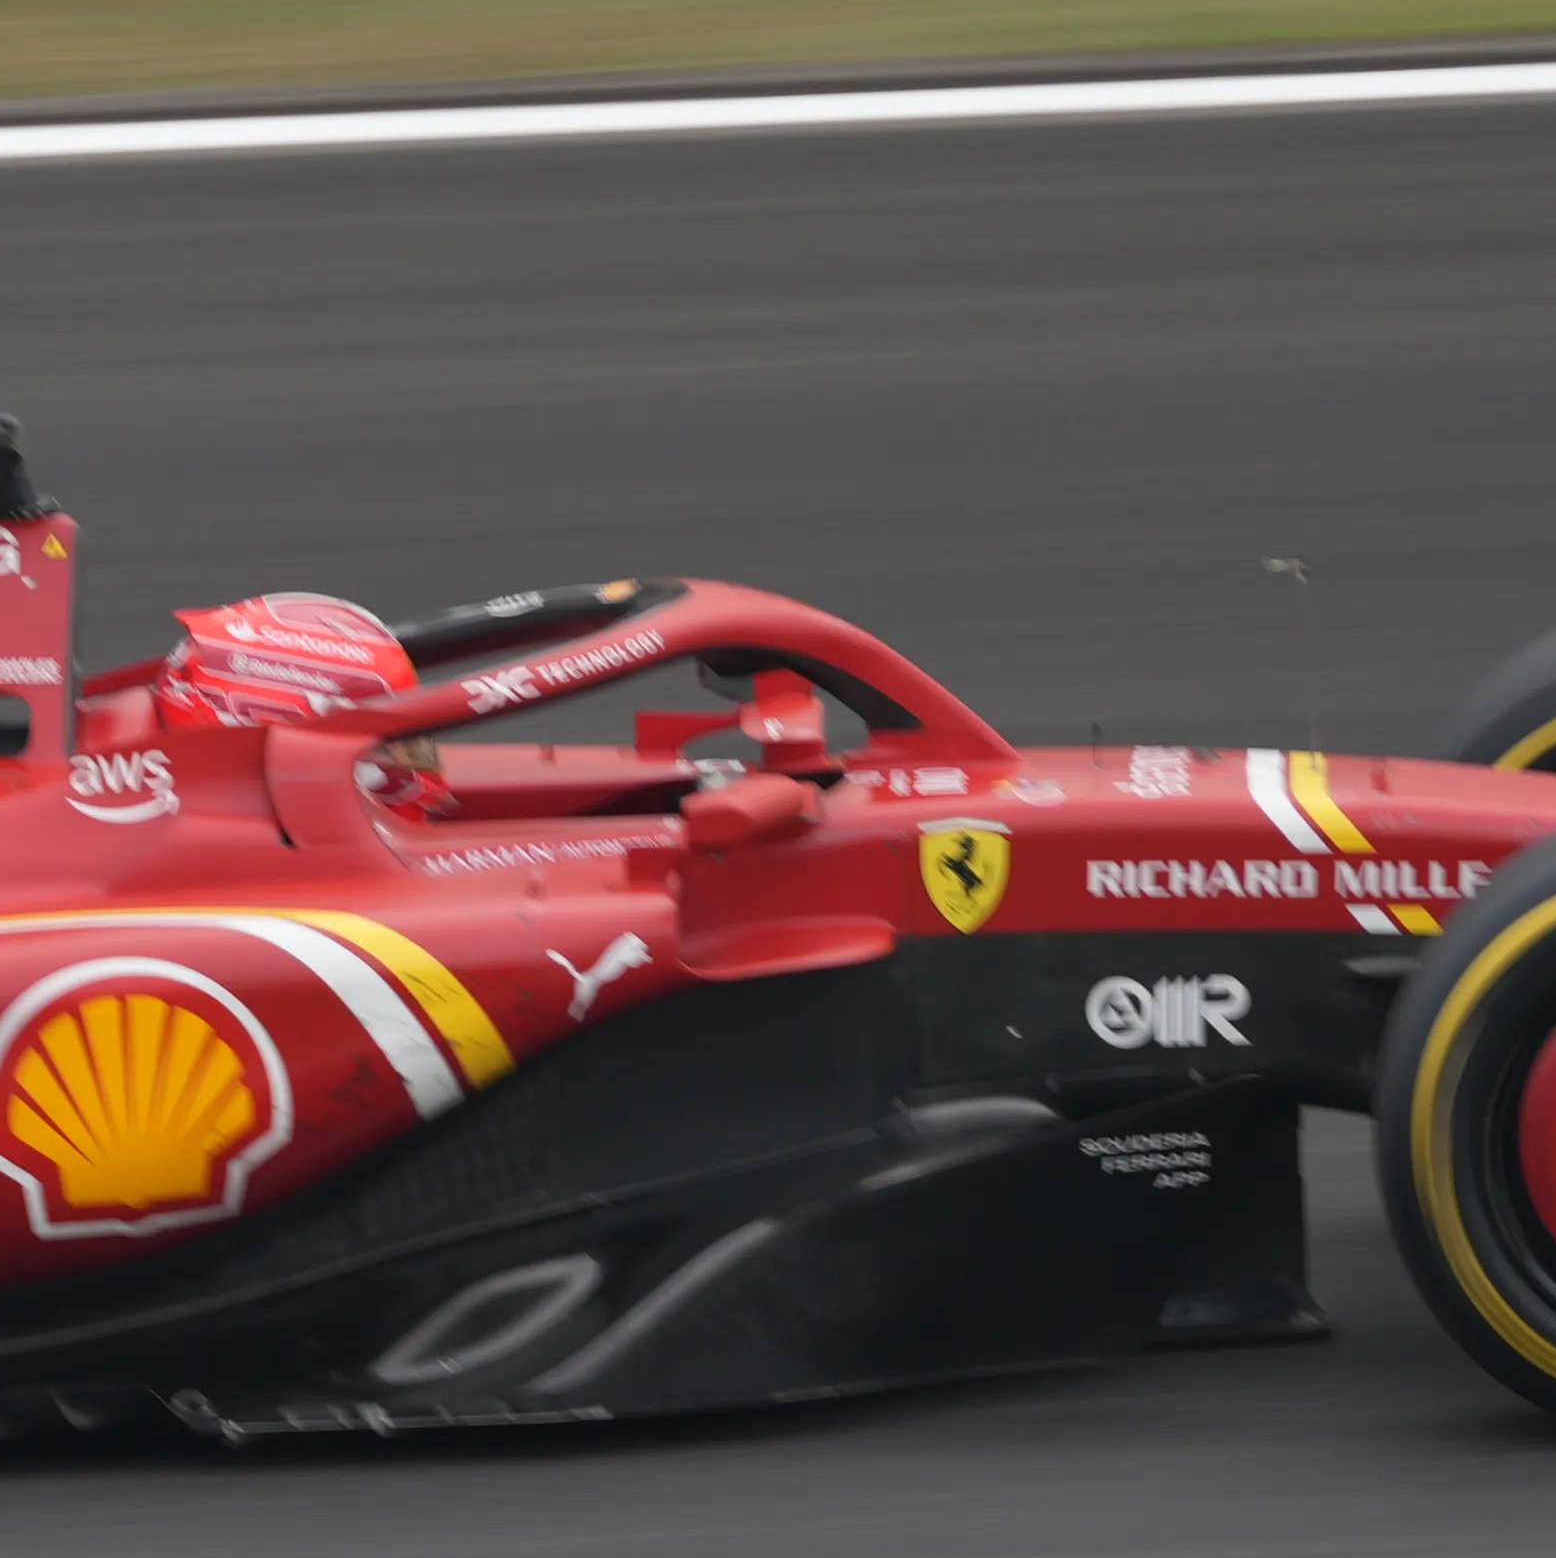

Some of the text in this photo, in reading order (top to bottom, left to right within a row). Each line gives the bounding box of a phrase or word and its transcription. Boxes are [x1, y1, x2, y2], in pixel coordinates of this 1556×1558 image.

[534, 628, 666, 686] TECHNOLOGY
[69, 749, 174, 796] aws
[1086, 859, 1319, 900] RICHARD
[1079, 1131, 1212, 1156] SCUDERIA
